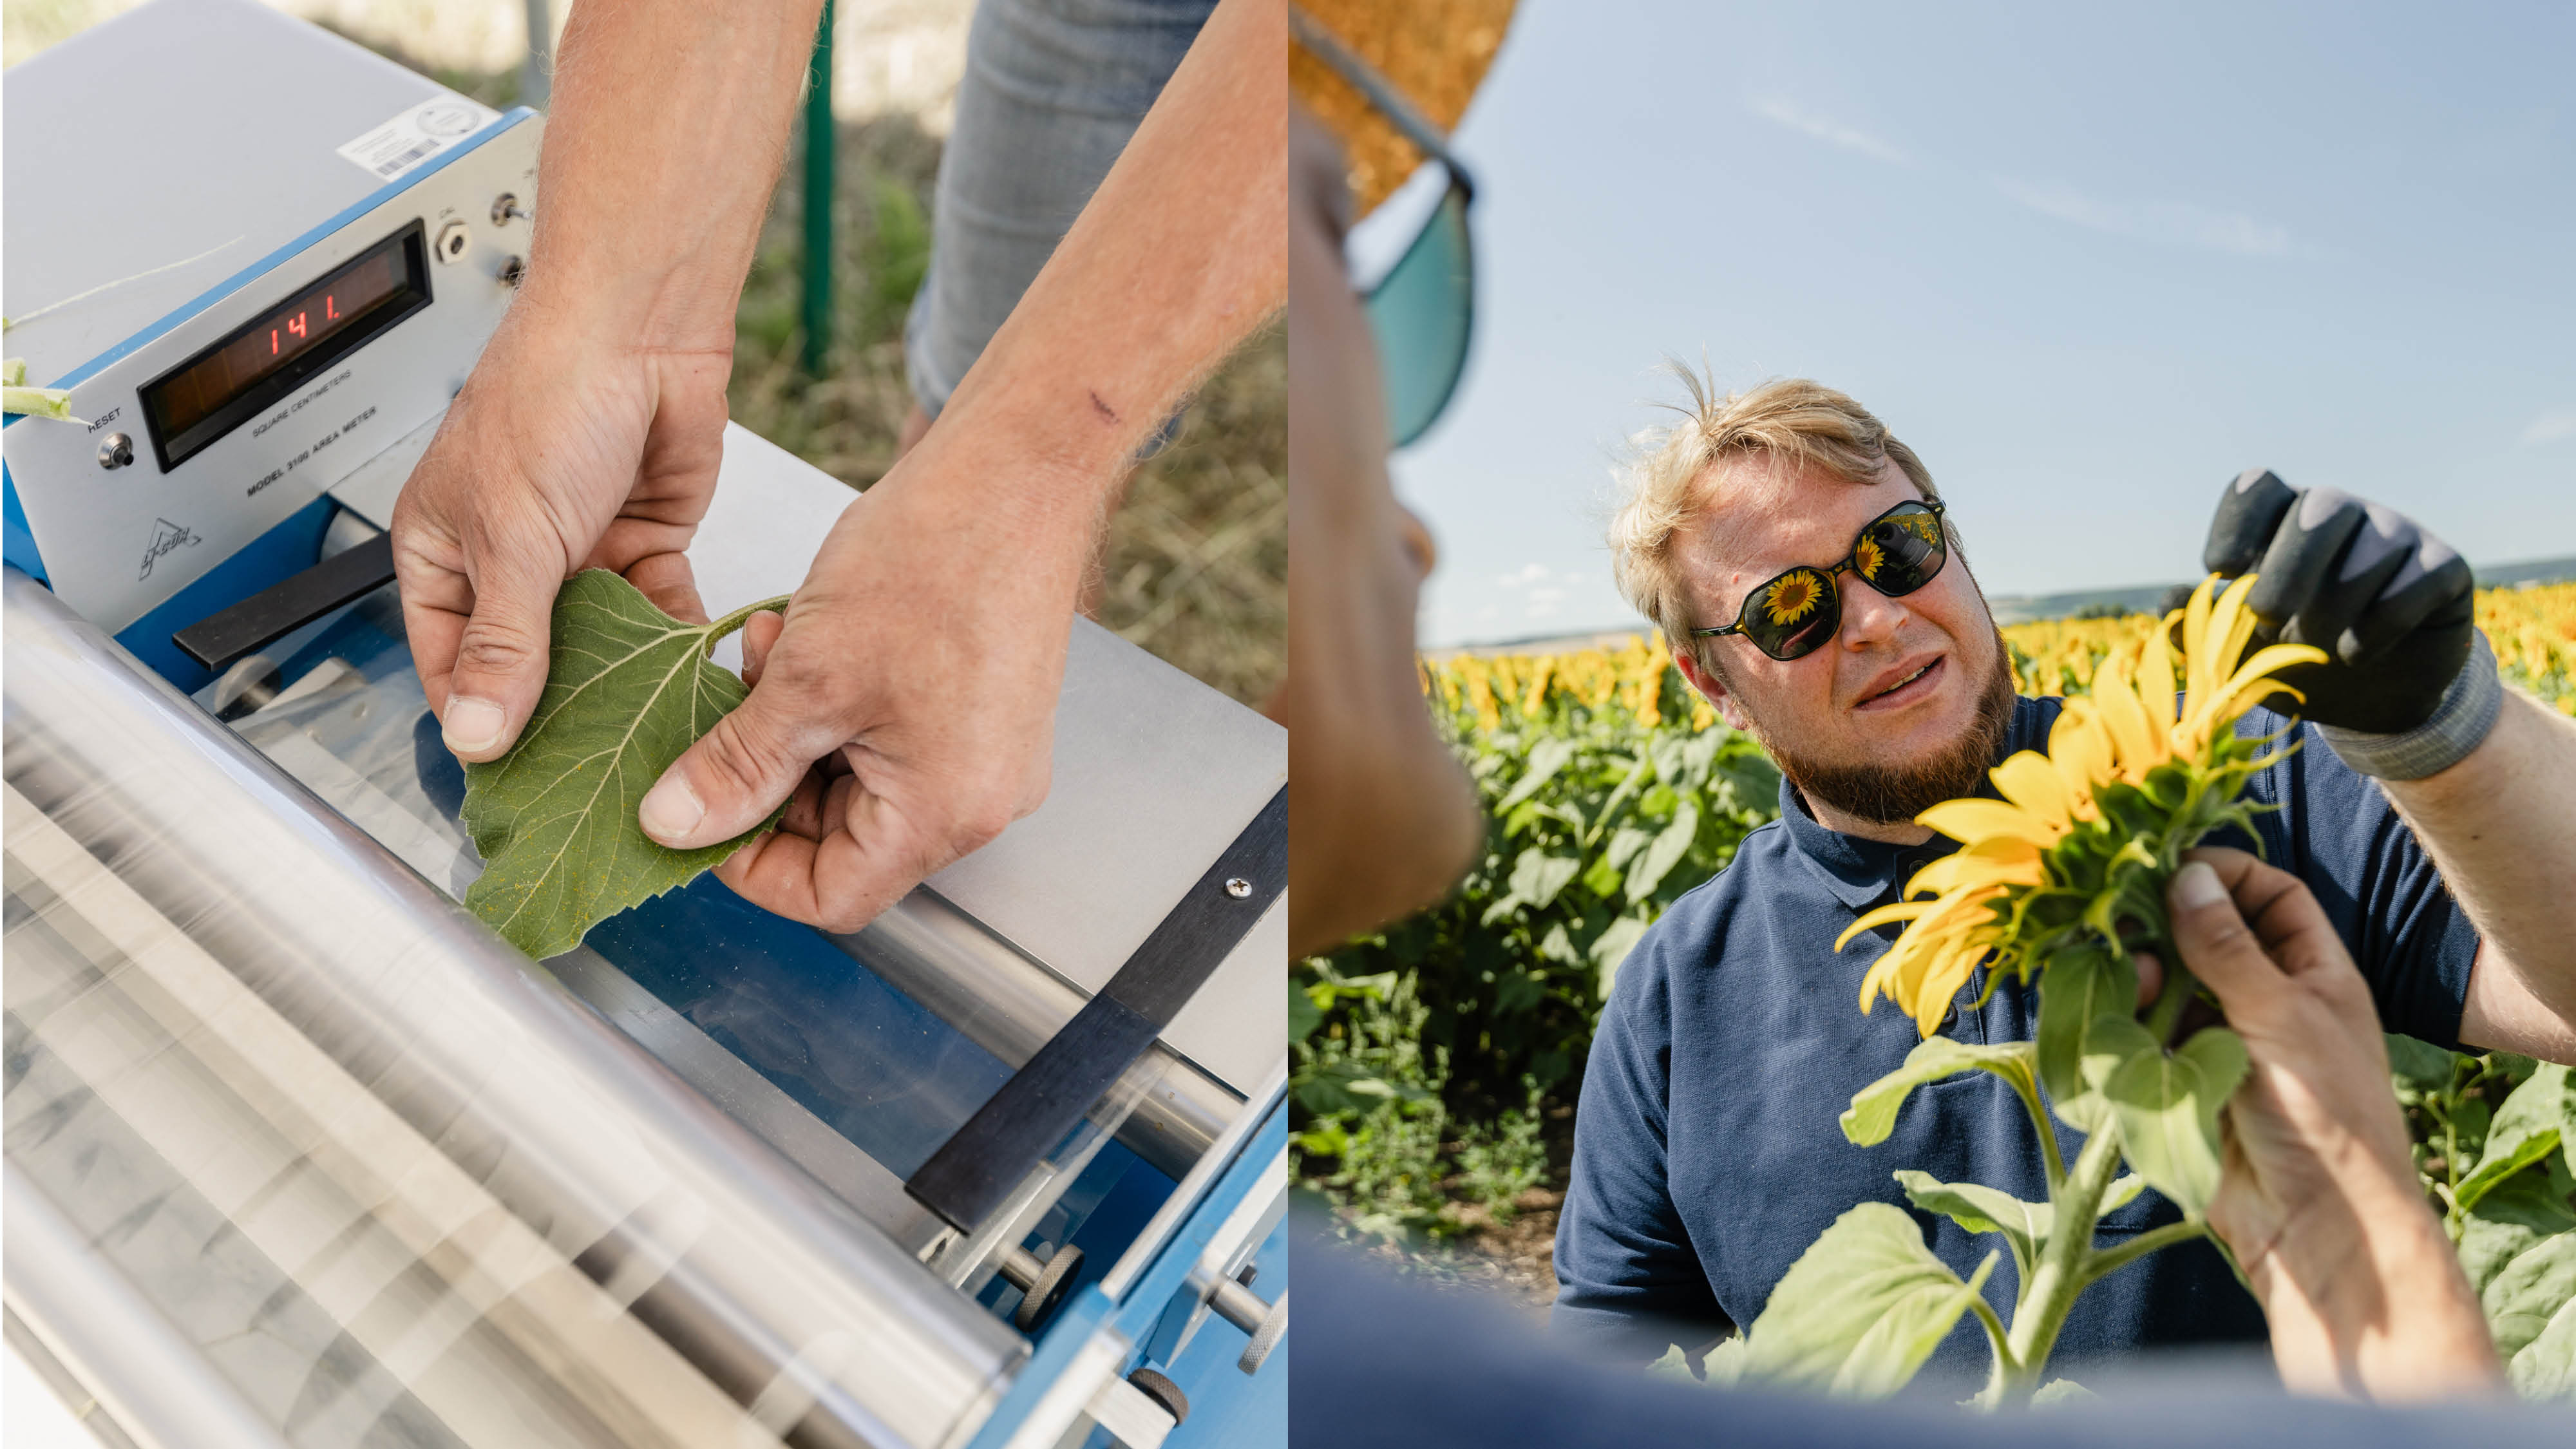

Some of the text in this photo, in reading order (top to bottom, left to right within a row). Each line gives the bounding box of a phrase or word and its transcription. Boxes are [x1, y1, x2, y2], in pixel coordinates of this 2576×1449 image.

[88, 406, 121, 433] RESET
[252, 369, 352, 438] SQUARE CENTIMETERS
[247, 405, 377, 498] MODEL 3100 AREA METER
